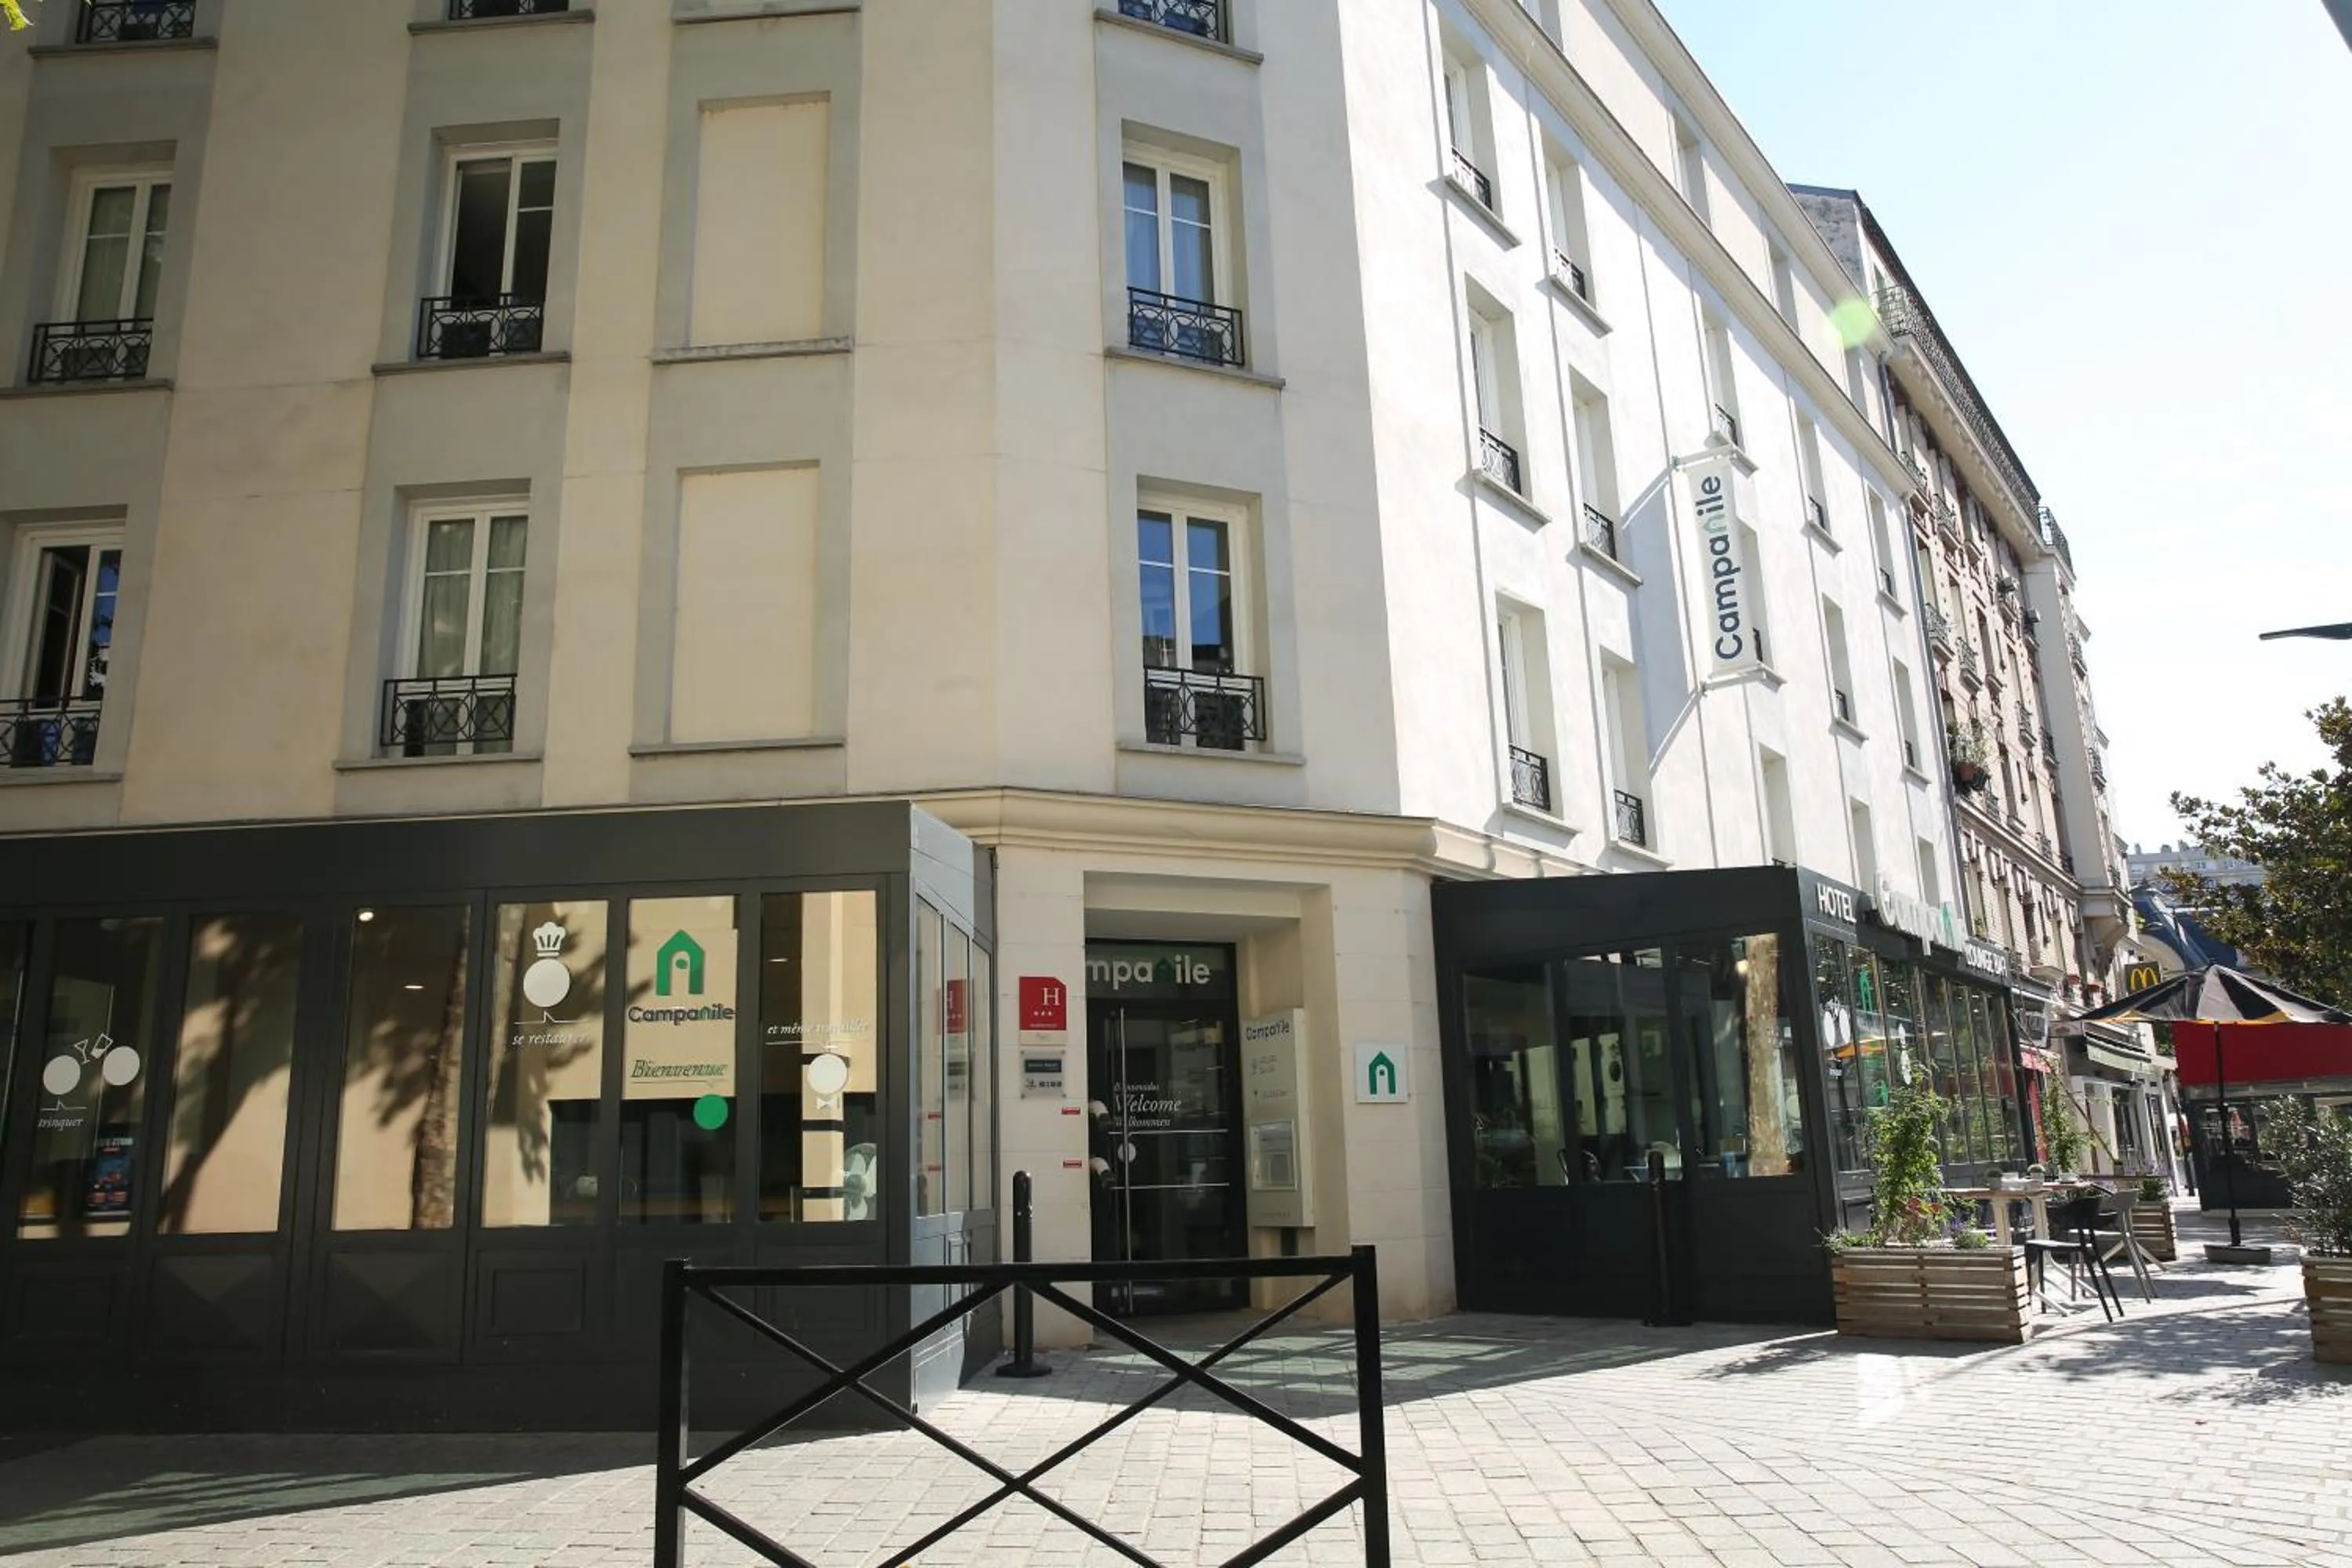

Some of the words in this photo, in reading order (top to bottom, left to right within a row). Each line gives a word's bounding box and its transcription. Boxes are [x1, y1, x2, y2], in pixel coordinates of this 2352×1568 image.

[1695, 475, 1743, 660] Campanile
[1817, 881, 1857, 923] HOTEL
[1041, 987, 1060, 1006] H
[628, 1003, 735, 1025] Campanile
